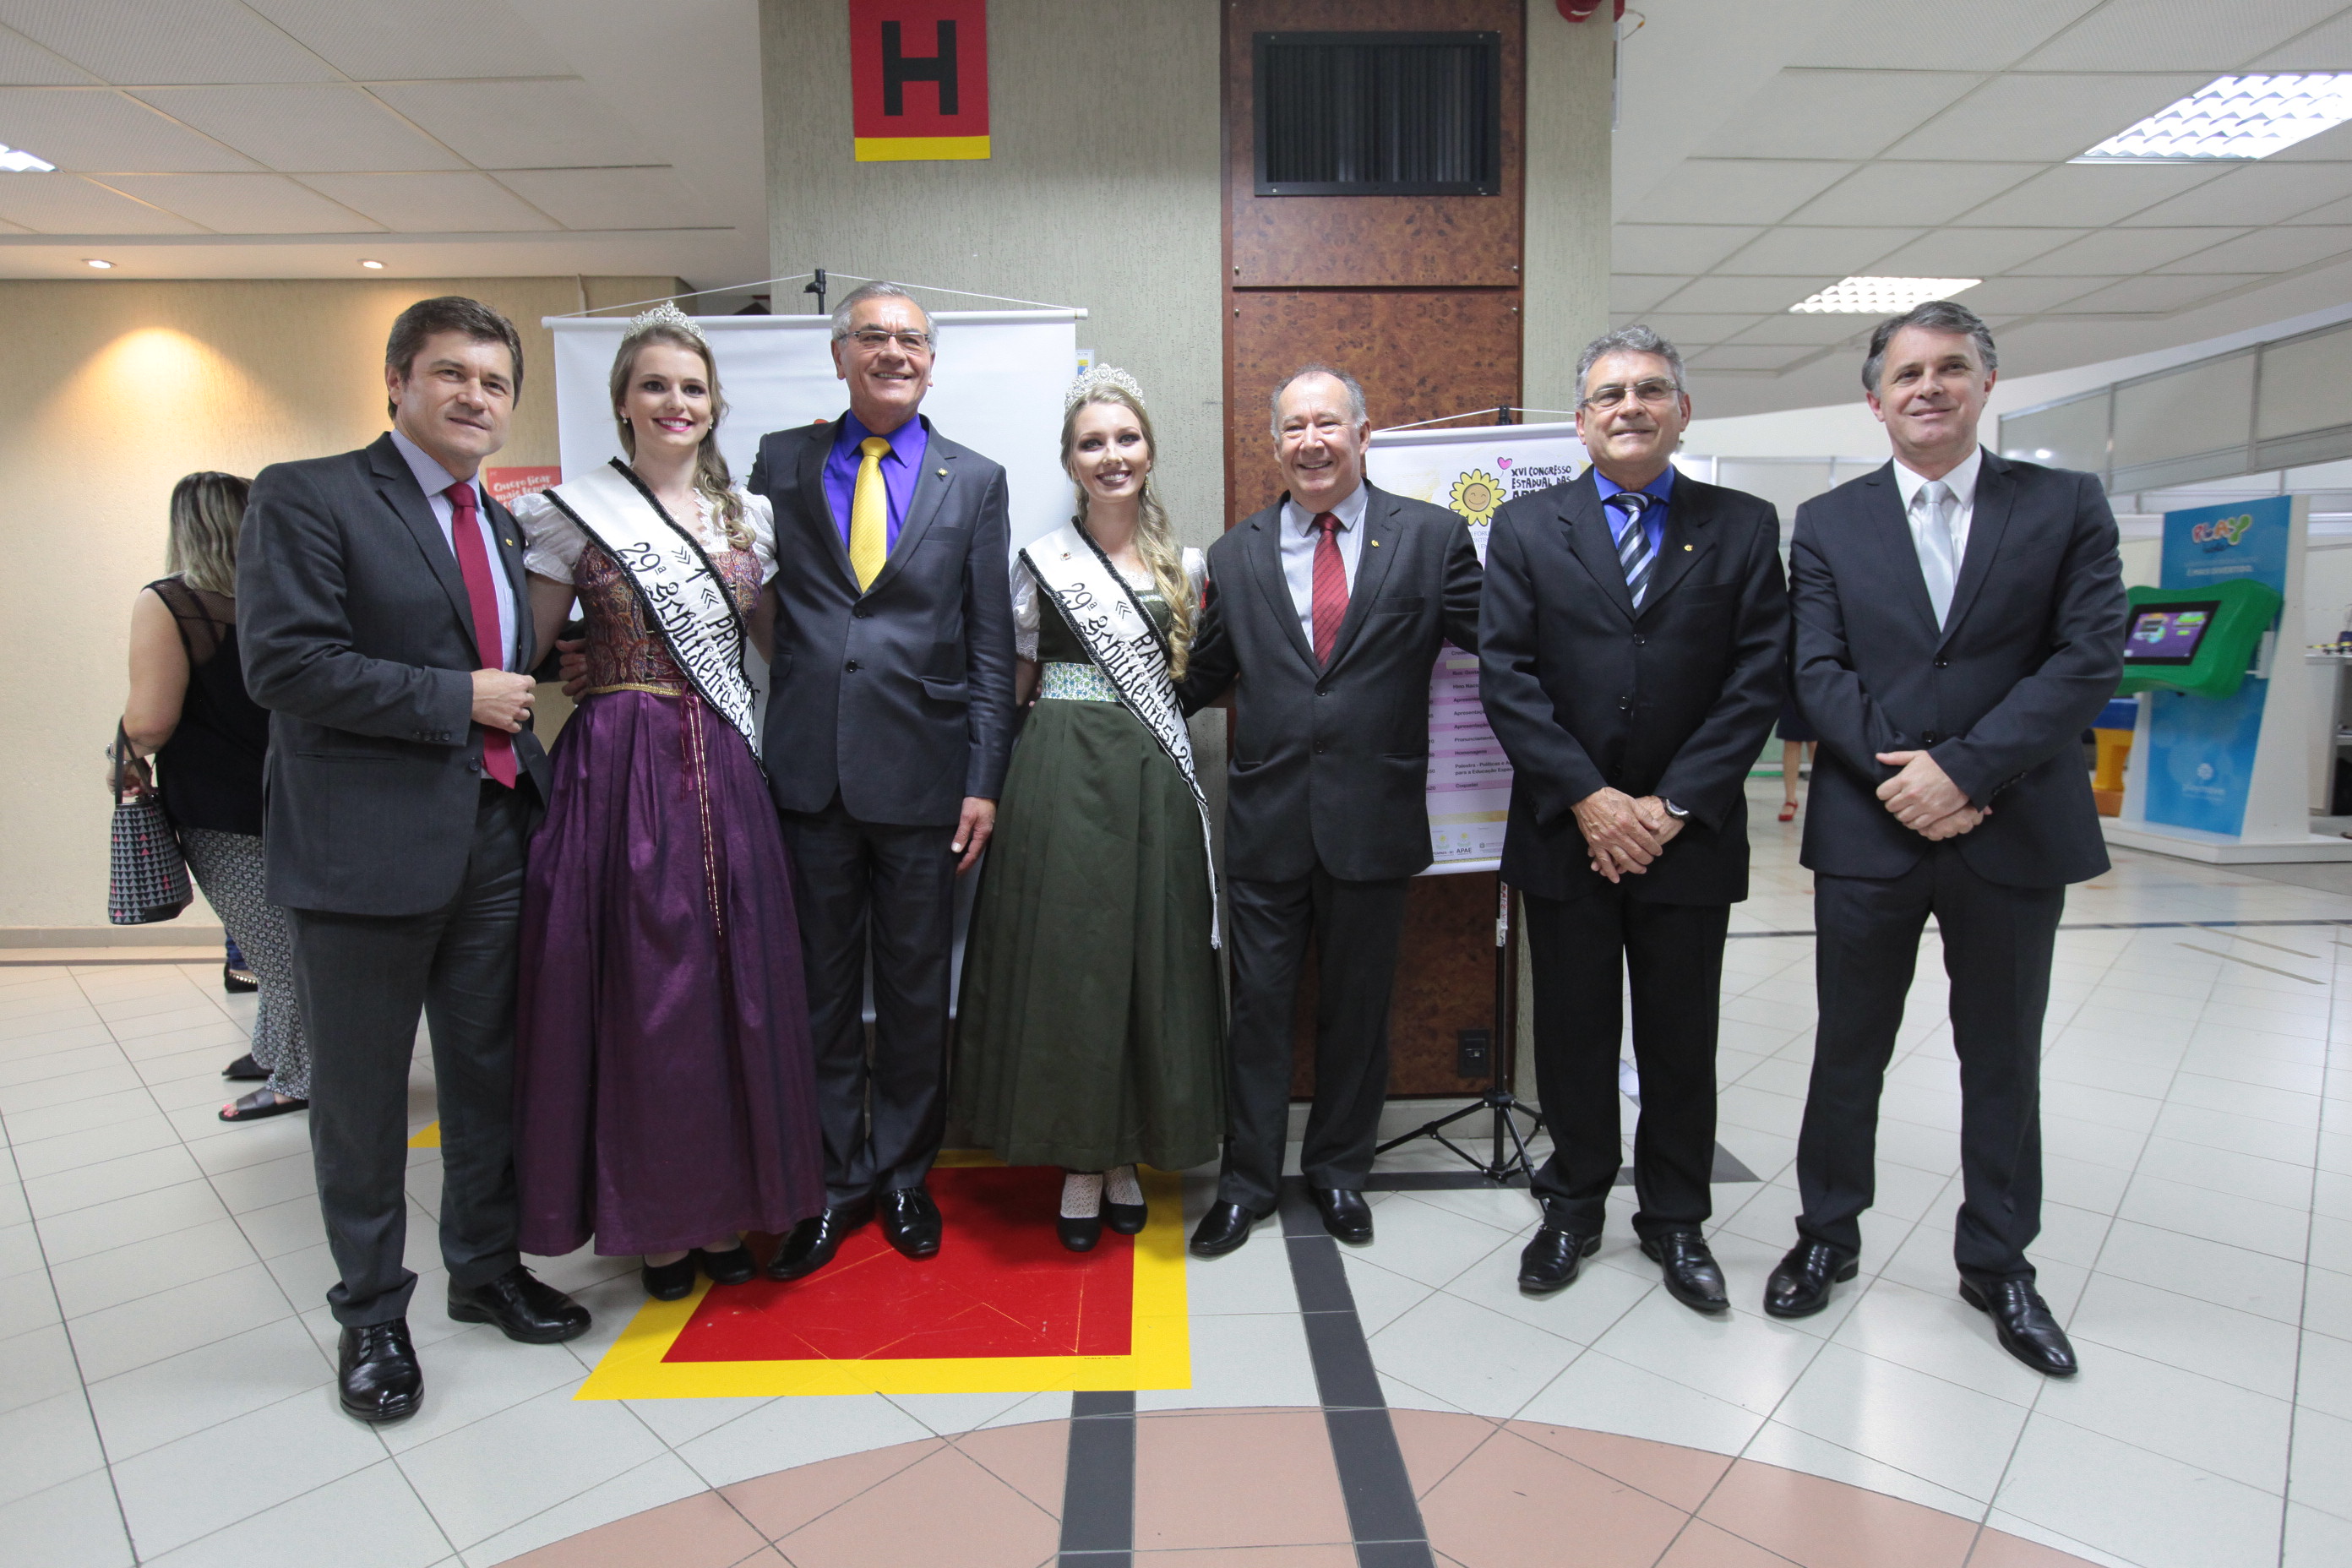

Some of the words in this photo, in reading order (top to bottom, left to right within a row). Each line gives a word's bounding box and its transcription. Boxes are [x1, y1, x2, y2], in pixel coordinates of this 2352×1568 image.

[881, 19, 958, 117] H
[1511, 466, 1527, 477] XVI
[1528, 465, 1572, 476] CONGRESSO
[1511, 476, 1553, 489] ESTADUAL
[1129, 630, 1179, 721] RAINHA
